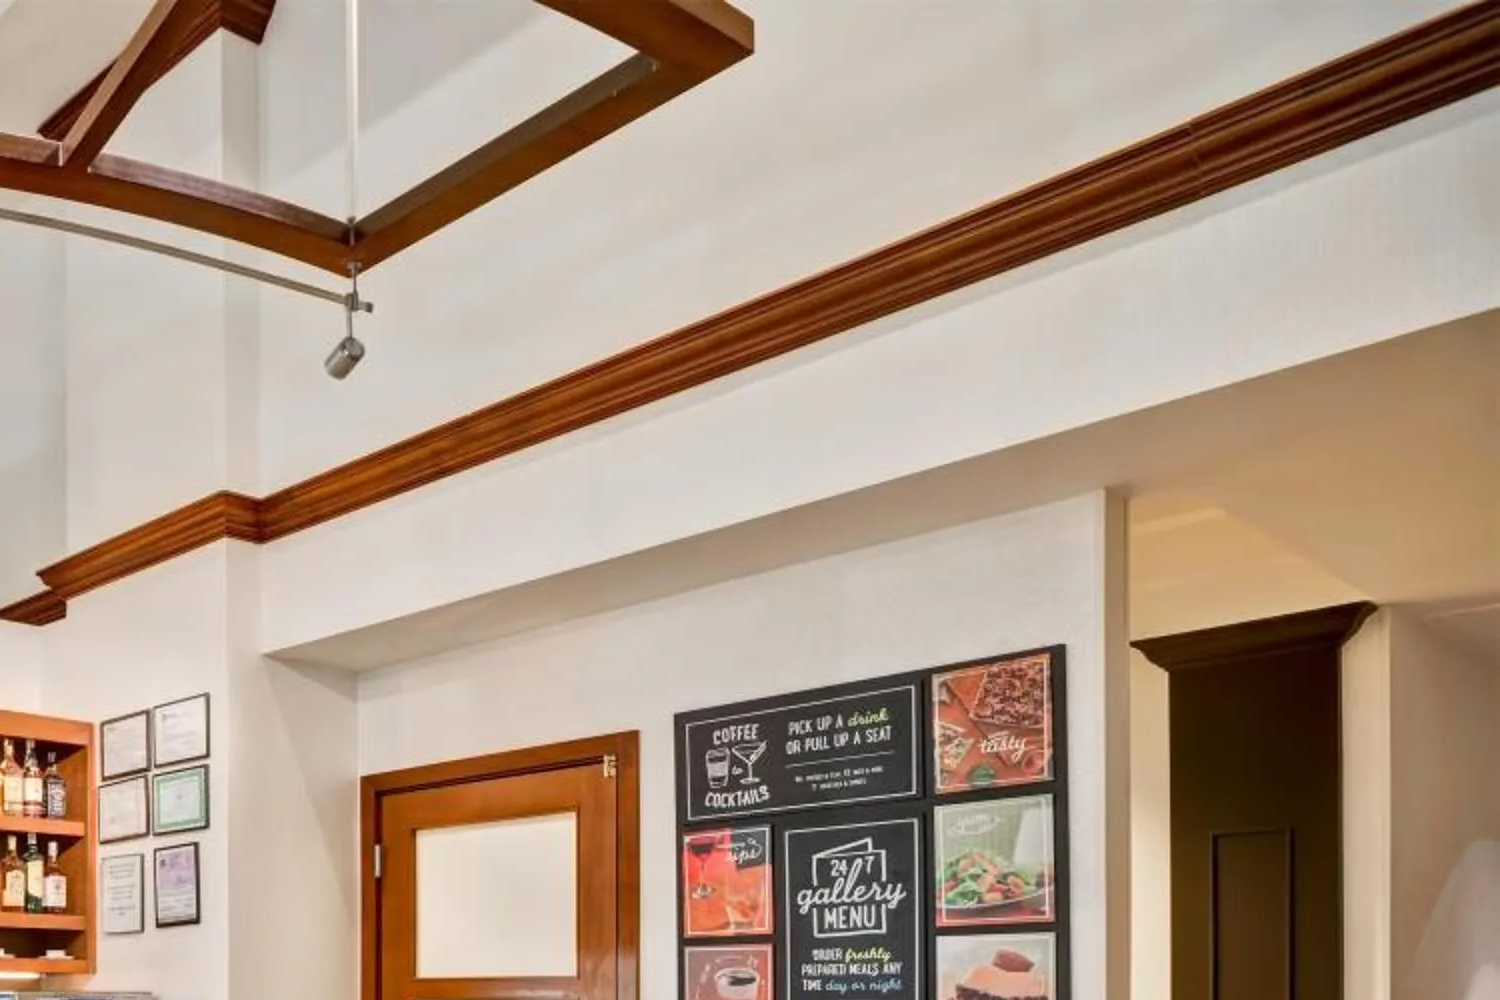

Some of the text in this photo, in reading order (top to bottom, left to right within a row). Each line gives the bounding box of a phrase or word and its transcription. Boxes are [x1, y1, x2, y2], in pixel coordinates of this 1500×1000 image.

[713, 723, 760, 745] COFFEE
[788, 707, 890, 736] PICK UP A drink
[786, 725, 892, 755] OR PULL UP A SEAT
[980, 735, 1027, 763] tasty
[705, 785, 771, 808] COCKTAILS
[797, 857, 907, 915] gallery
[824, 904, 876, 929] MENU
[849, 962, 879, 976] MEALS
[825, 979, 848, 994] day
